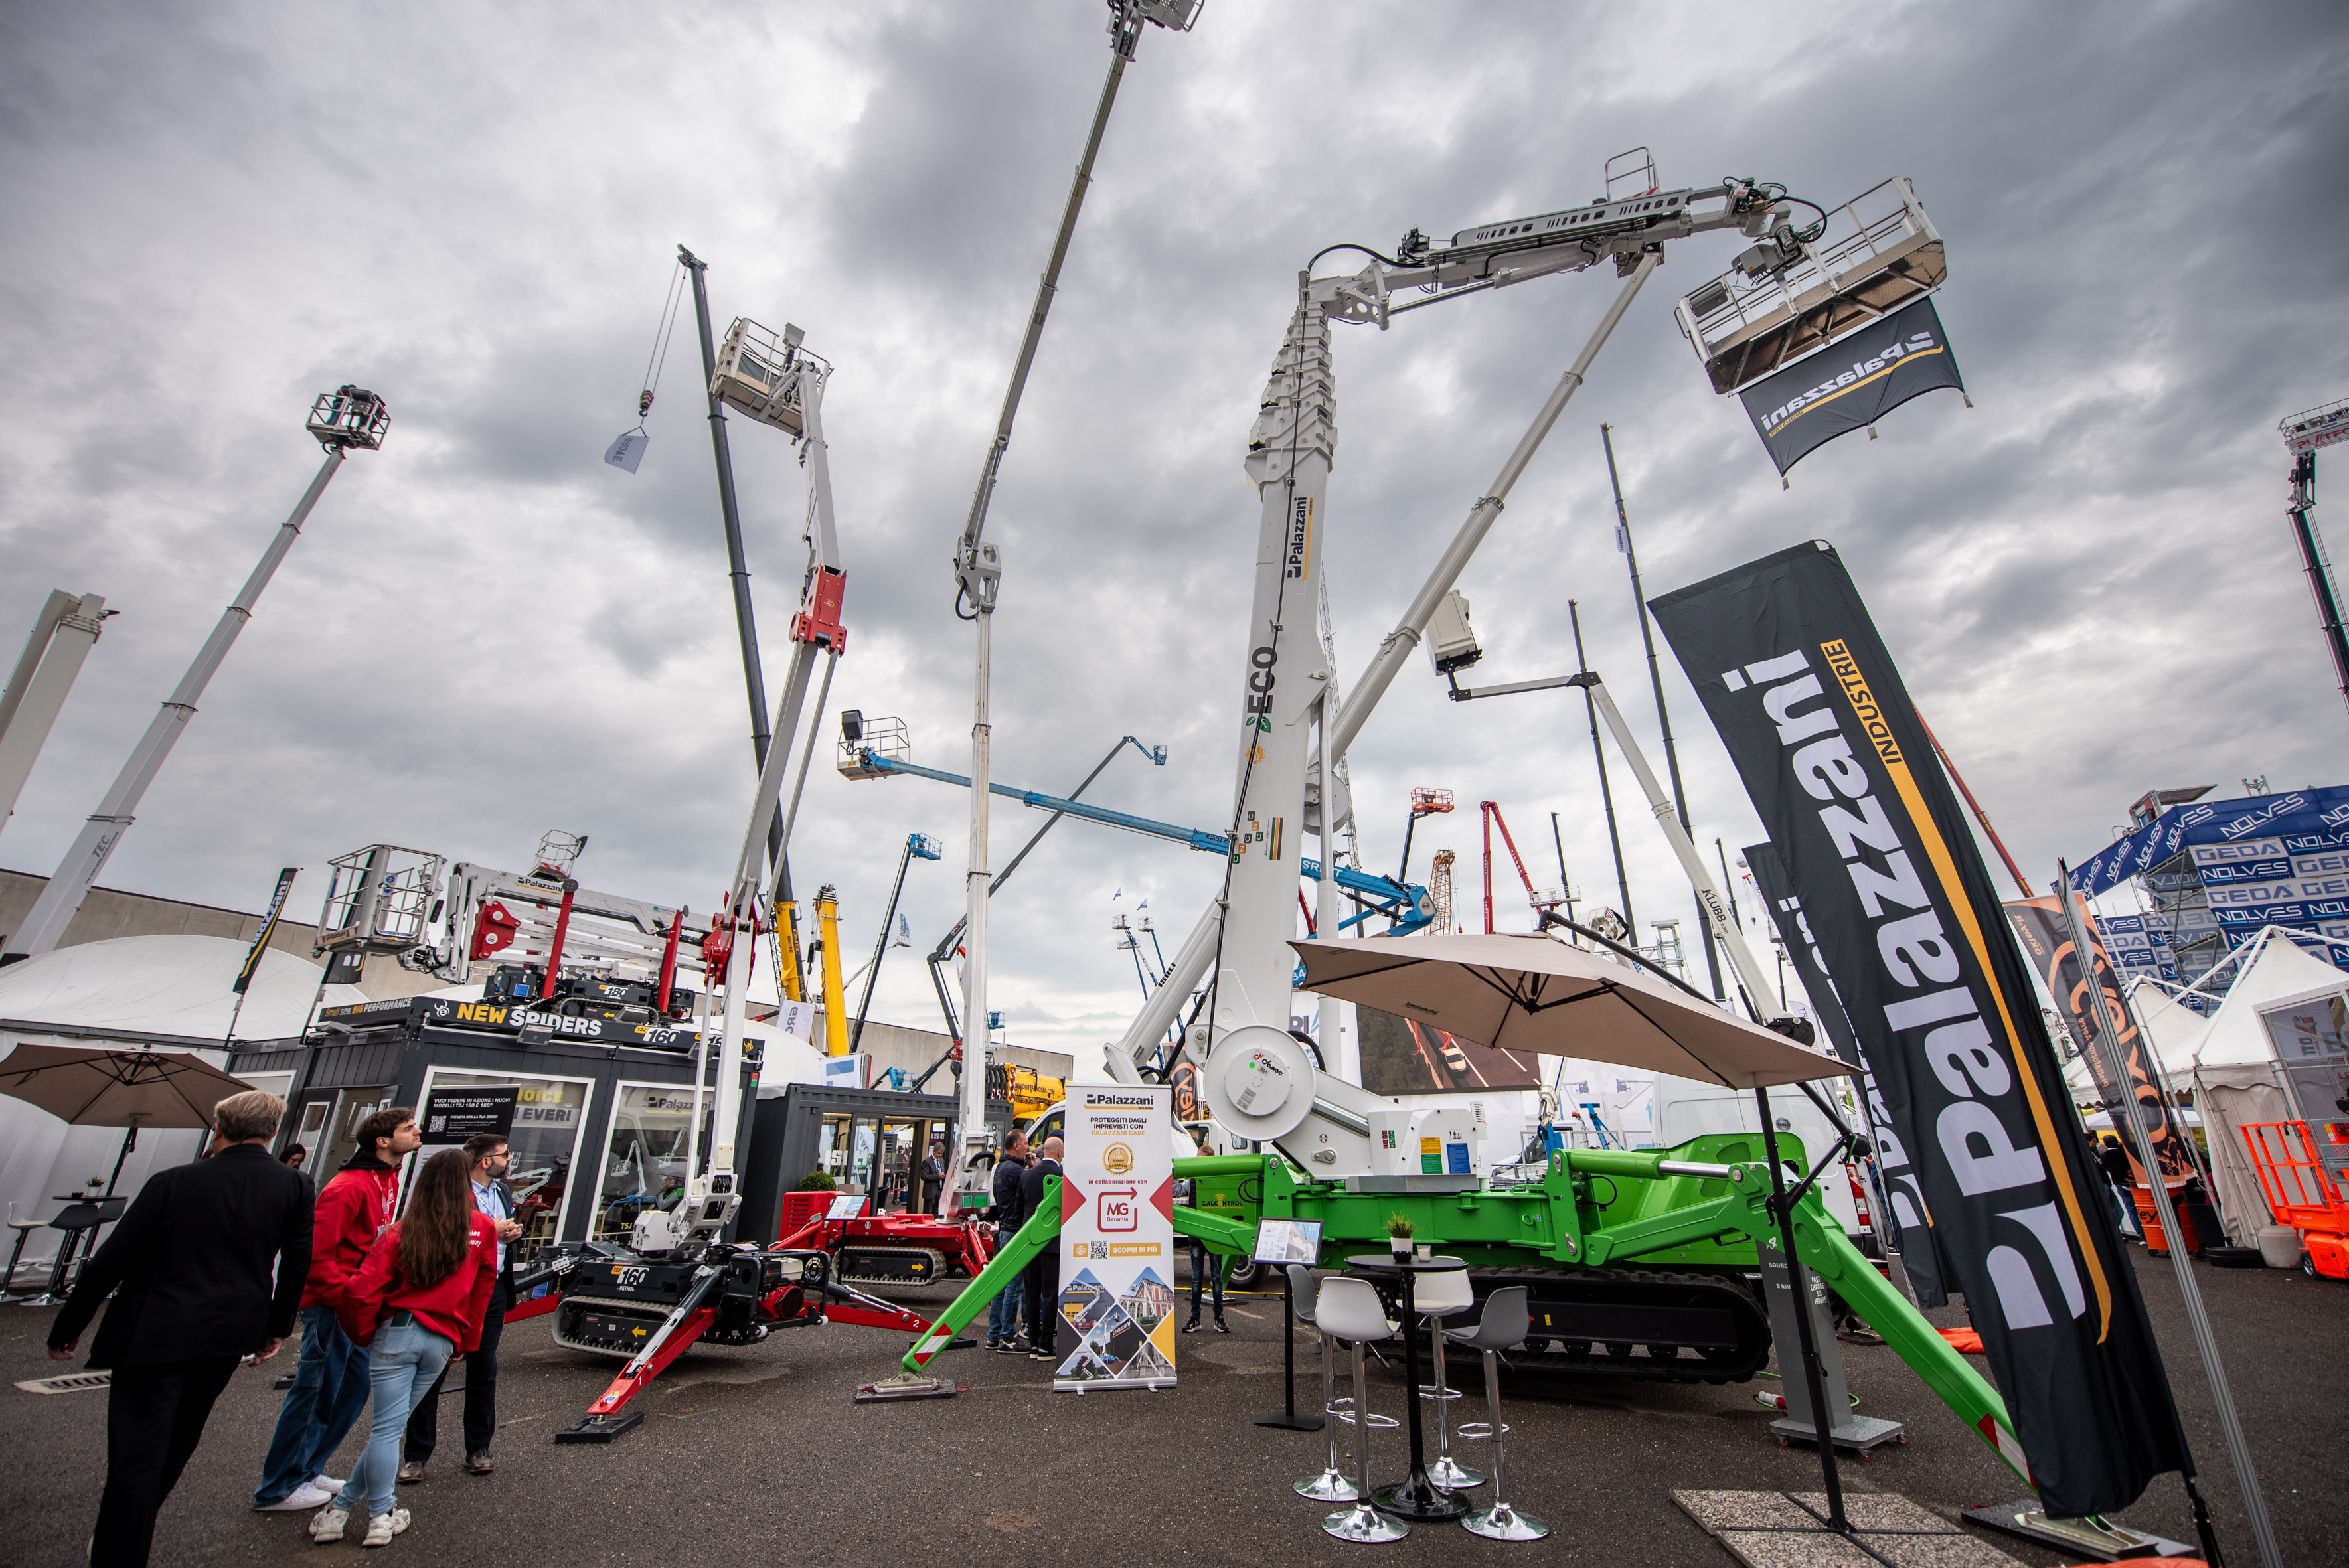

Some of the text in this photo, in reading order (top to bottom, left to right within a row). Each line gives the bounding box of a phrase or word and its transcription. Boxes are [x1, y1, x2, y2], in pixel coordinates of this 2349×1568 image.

[2297, 427, 2349, 449] PLATFO
[1289, 497, 1307, 564] Palazzani
[1247, 646, 1278, 714] ECO
[1822, 639, 1903, 765] INDUSTRIE
[2220, 793, 2305, 840] NOLVES
[2166, 805, 2214, 854] NOLVES
[92, 835, 110, 858] TEC
[2135, 821, 2162, 870] NOLVES
[2286, 832, 2349, 850] NOLV
[2106, 838, 2132, 883] NOLVES
[2201, 861, 2289, 880] NOLVES
[525, 879, 564, 892] Palazzani
[1701, 888, 1726, 923] KLUBB
[2214, 905, 2303, 922] NOLVES
[1719, 922, 1729, 935] .com
[1721, 649, 2046, 1196] Palazzani
[1158, 961, 1176, 988] ISOLI
[608, 986, 627, 996] 180
[325, 1006, 339, 1018] Small
[352, 1004, 364, 1014] BIG
[363, 997, 412, 1014] PERFORMANCE
[457, 1003, 602, 1036] NEW SPIDERS
[647, 1029, 678, 1043] 160
[658, 1097, 712, 1111] Palazzni
[1097, 1095, 1154, 1105] Palazzani
[522, 1107, 572, 1122] EVER!
[1107, 1202, 1129, 1215] MG
[621, 1267, 647, 1285] 160
[1810, 1283, 1825, 1291] CHARGE
[1814, 1296, 1827, 1305] HOURS
